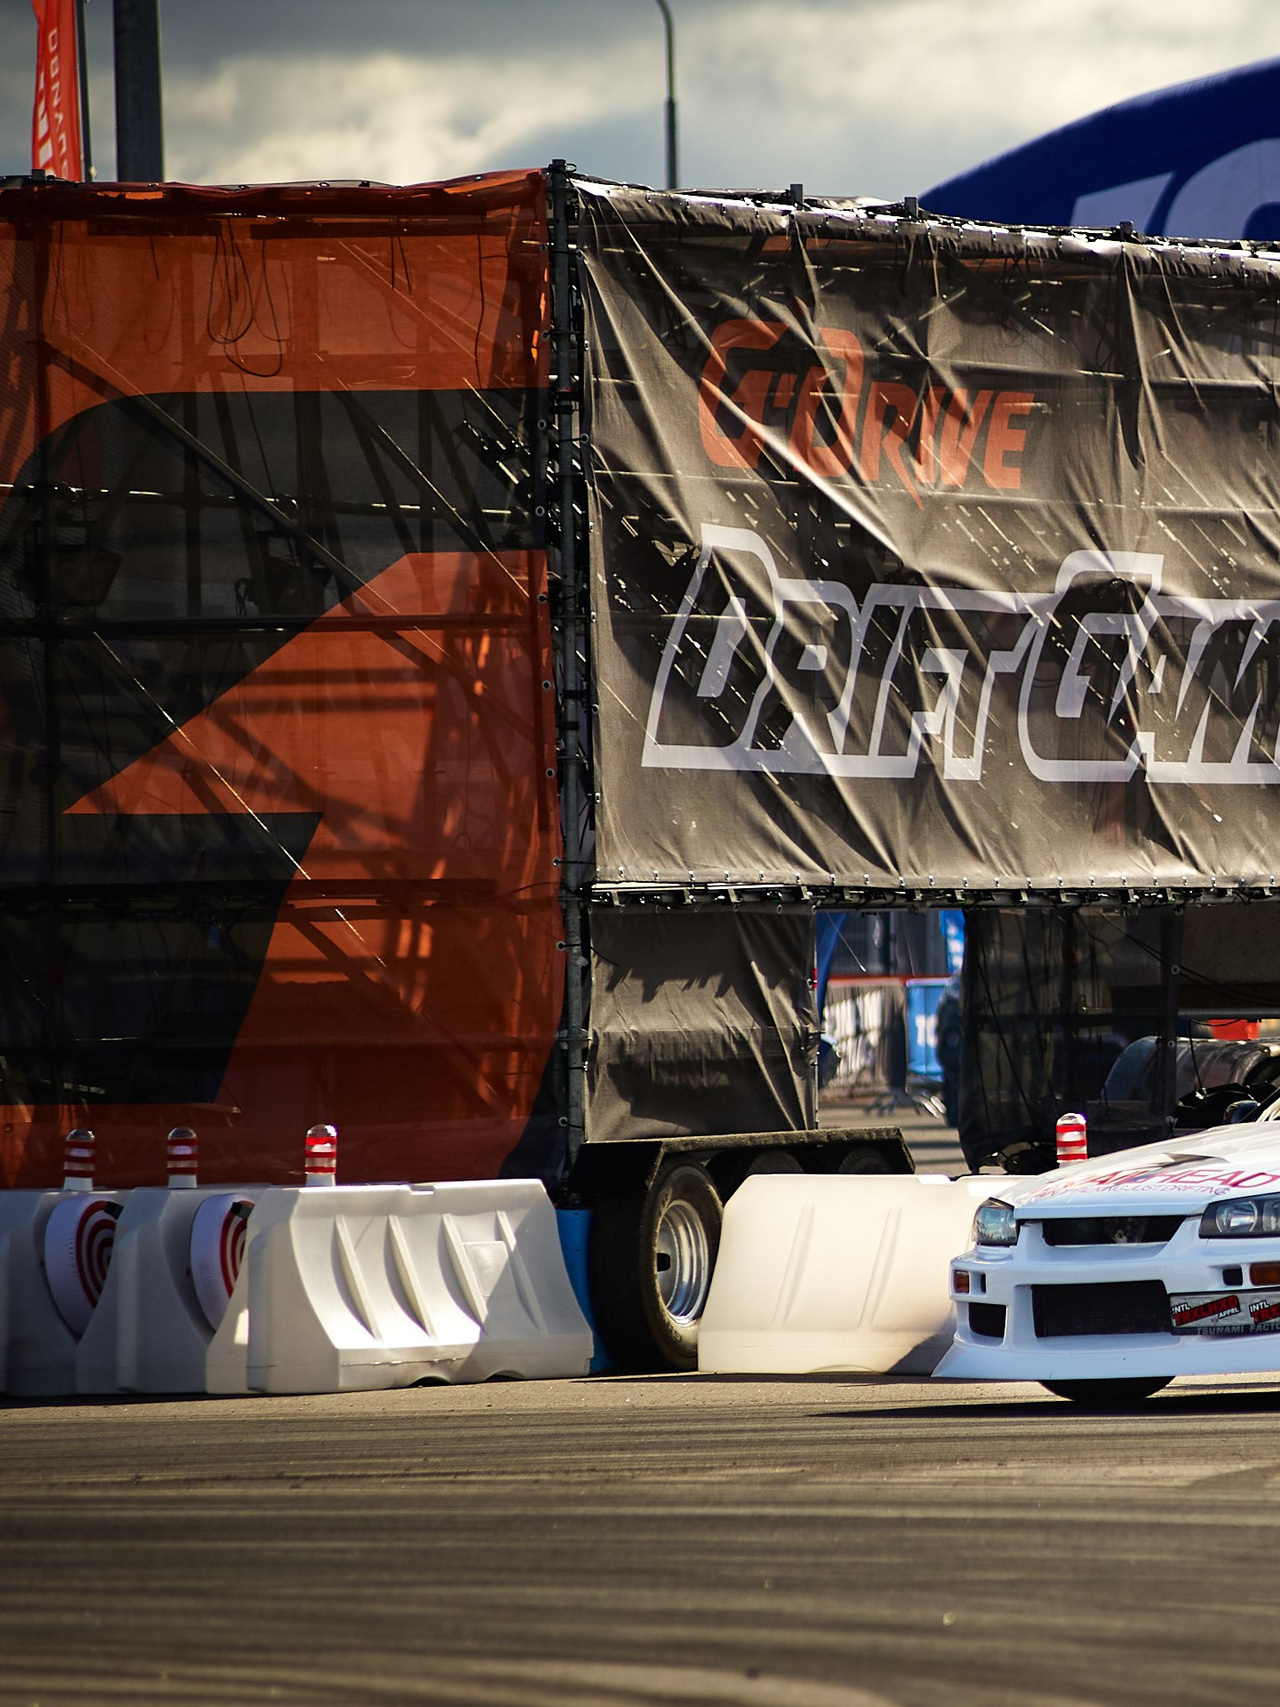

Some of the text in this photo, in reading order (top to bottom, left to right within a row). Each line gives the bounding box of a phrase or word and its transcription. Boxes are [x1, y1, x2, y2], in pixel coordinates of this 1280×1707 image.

[641, 523, 1040, 781] DRIFT
[1250, 1301, 1269, 1313] INTL
[1197, 1326, 1244, 1336] TSUNAMI
